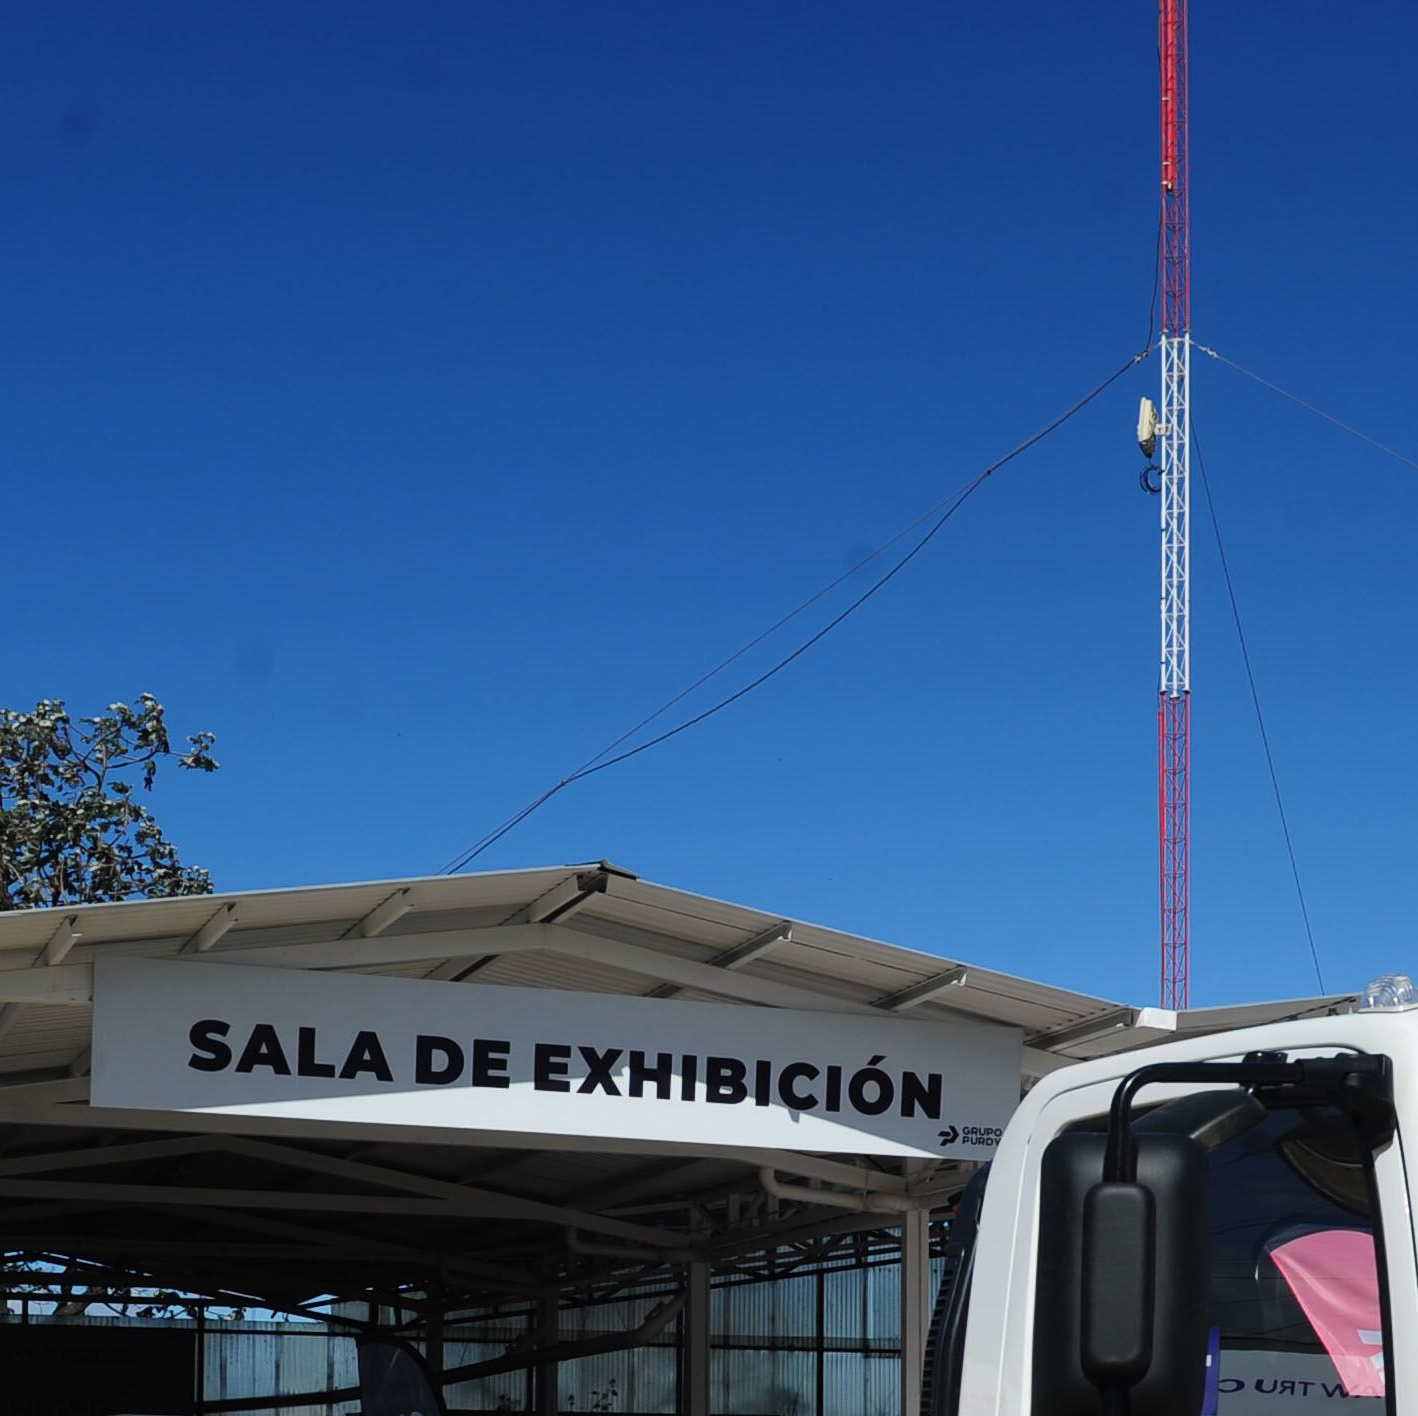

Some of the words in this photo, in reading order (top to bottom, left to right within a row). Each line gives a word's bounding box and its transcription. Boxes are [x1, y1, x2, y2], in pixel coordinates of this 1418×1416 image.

[187, 1019, 395, 1083] SALA
[414, 1034, 512, 1090] DE
[533, 1042, 943, 1120] EXHIBICIÓN
[961, 1125, 1004, 1138] GRUPO
[961, 1135, 1002, 1148] PURDY
